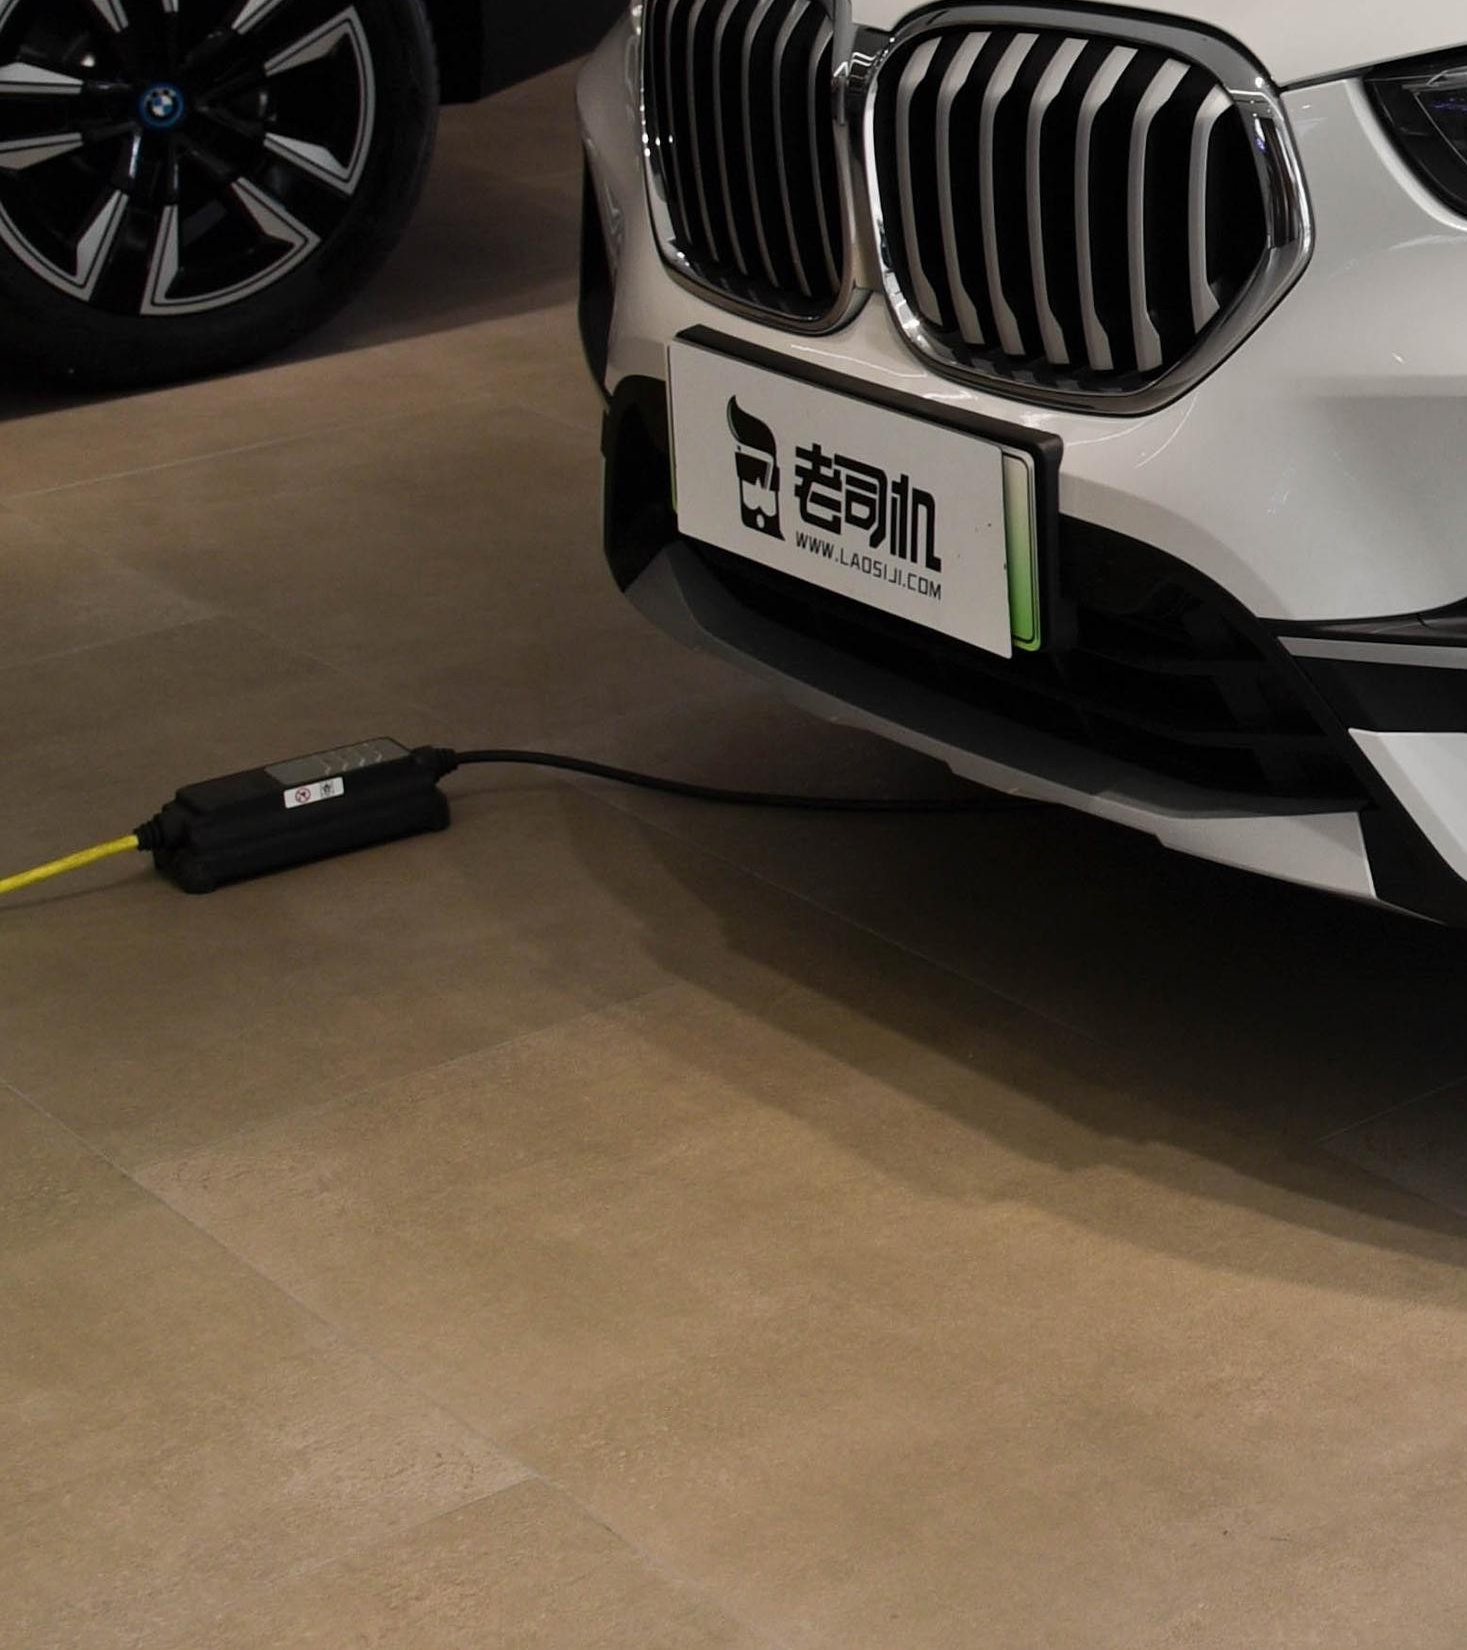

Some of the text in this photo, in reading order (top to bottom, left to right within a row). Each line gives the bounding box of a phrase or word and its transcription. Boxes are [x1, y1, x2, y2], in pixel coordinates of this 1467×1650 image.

[794, 442, 942, 572] 老司机
[795, 530, 942, 601] WWW.LAOSIJI.COM
